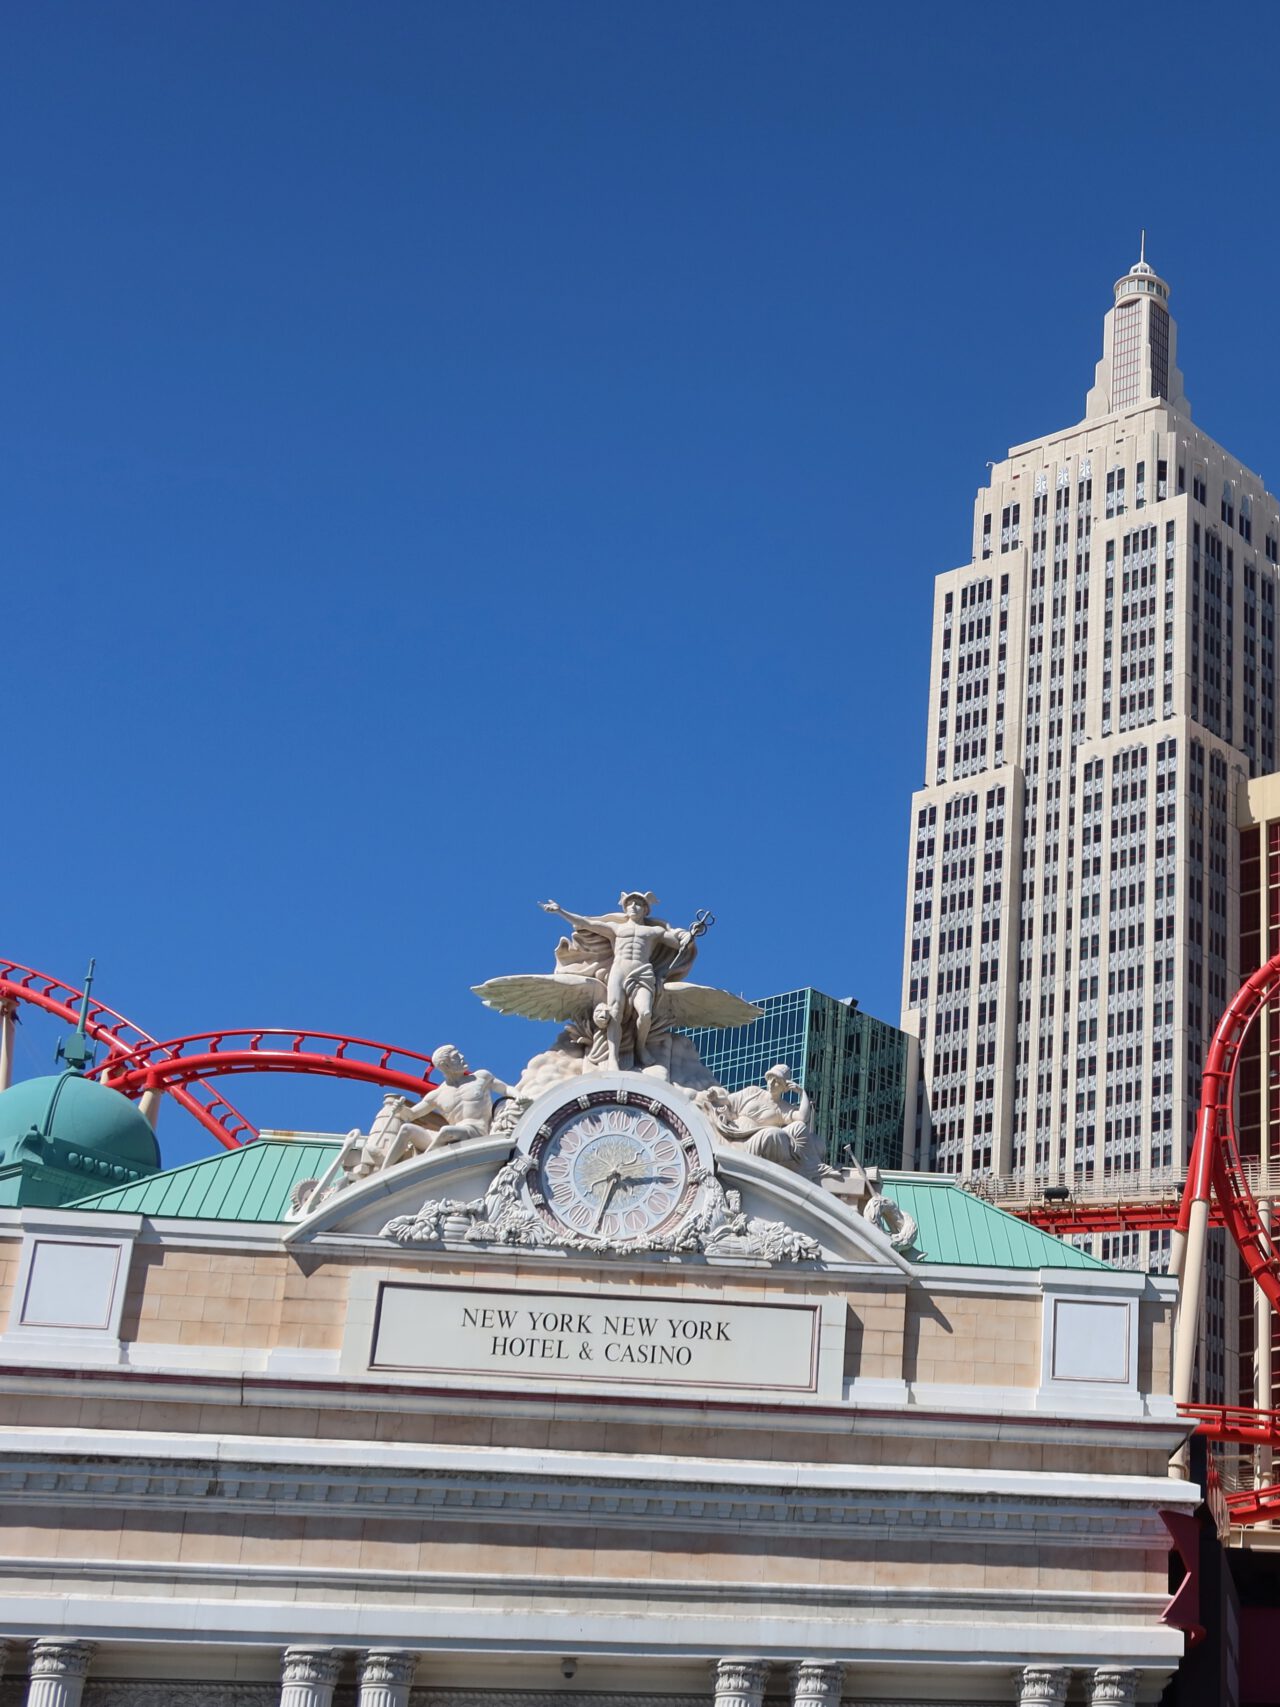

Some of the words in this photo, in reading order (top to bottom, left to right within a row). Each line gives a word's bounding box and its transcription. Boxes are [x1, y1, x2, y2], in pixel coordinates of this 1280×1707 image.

[462, 1307, 517, 1330] NEW
[528, 1311, 593, 1334] YORK
[603, 1315, 657, 1338] NEW
[668, 1319, 732, 1342] YORK
[491, 1336, 569, 1360] HOTEL
[578, 1341, 594, 1361] &
[605, 1343, 692, 1367] CASINO
